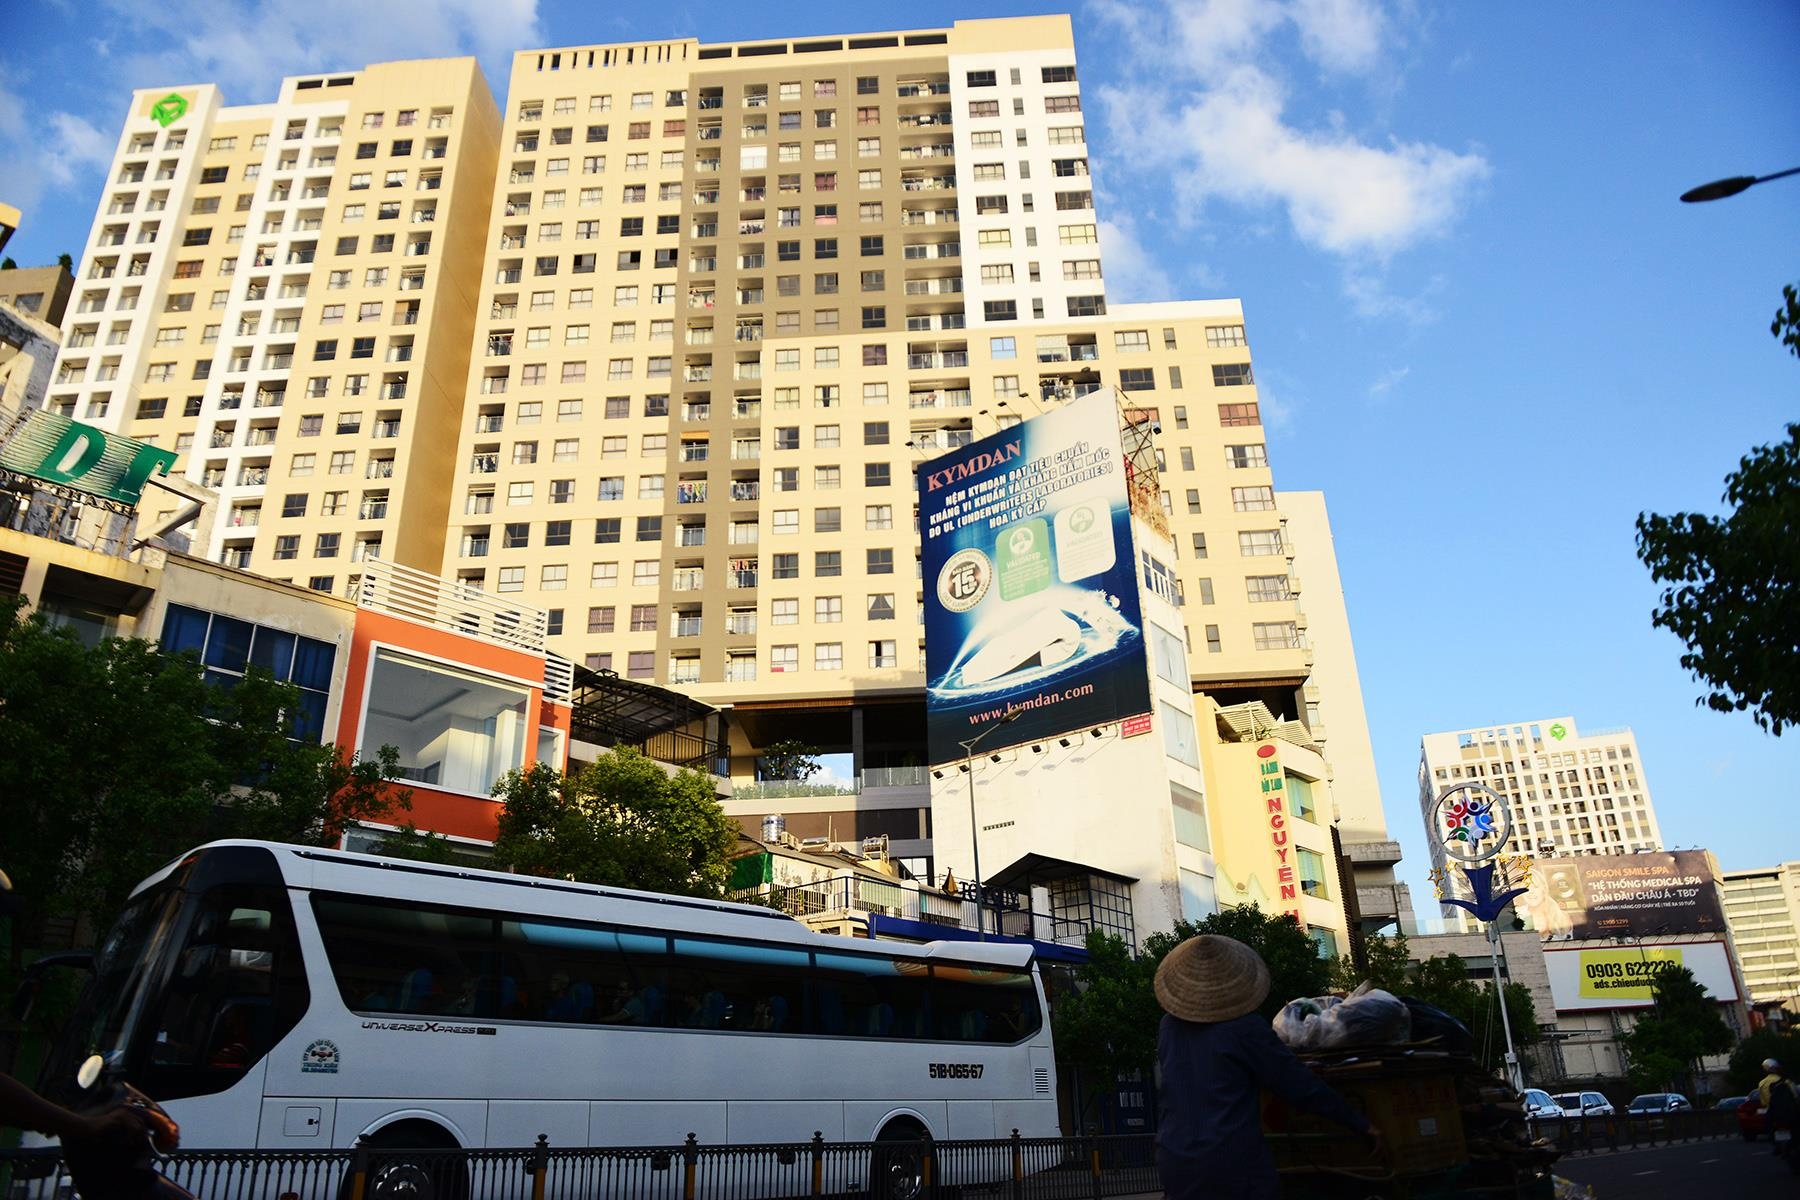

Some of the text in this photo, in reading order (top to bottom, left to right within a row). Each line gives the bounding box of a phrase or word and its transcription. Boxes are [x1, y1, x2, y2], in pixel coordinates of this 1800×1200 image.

[927, 440, 1021, 492] KYMDAN
[968, 474, 1006, 497] KYMDAN
[929, 461, 1113, 539] DO UL (UNDERWRITERS LABORATORIES)
[930, 505, 960, 525] KHÁNG
[962, 500, 972, 513] VI
[1008, 480, 1021, 495] VÀ
[1023, 468, 1057, 489] KHÁNG
[989, 513, 1009, 529] HOA
[951, 568, 976, 598] 15
[1585, 865, 1670, 879] SAIGON SMILE SPA
[1607, 878, 1641, 889] THỐNG
[1641, 876, 1684, 888] MEDICAL
[1684, 875, 1702, 885] SPA
[1635, 888, 1663, 900] CHÂU
[1586, 963, 1623, 978] 0903
